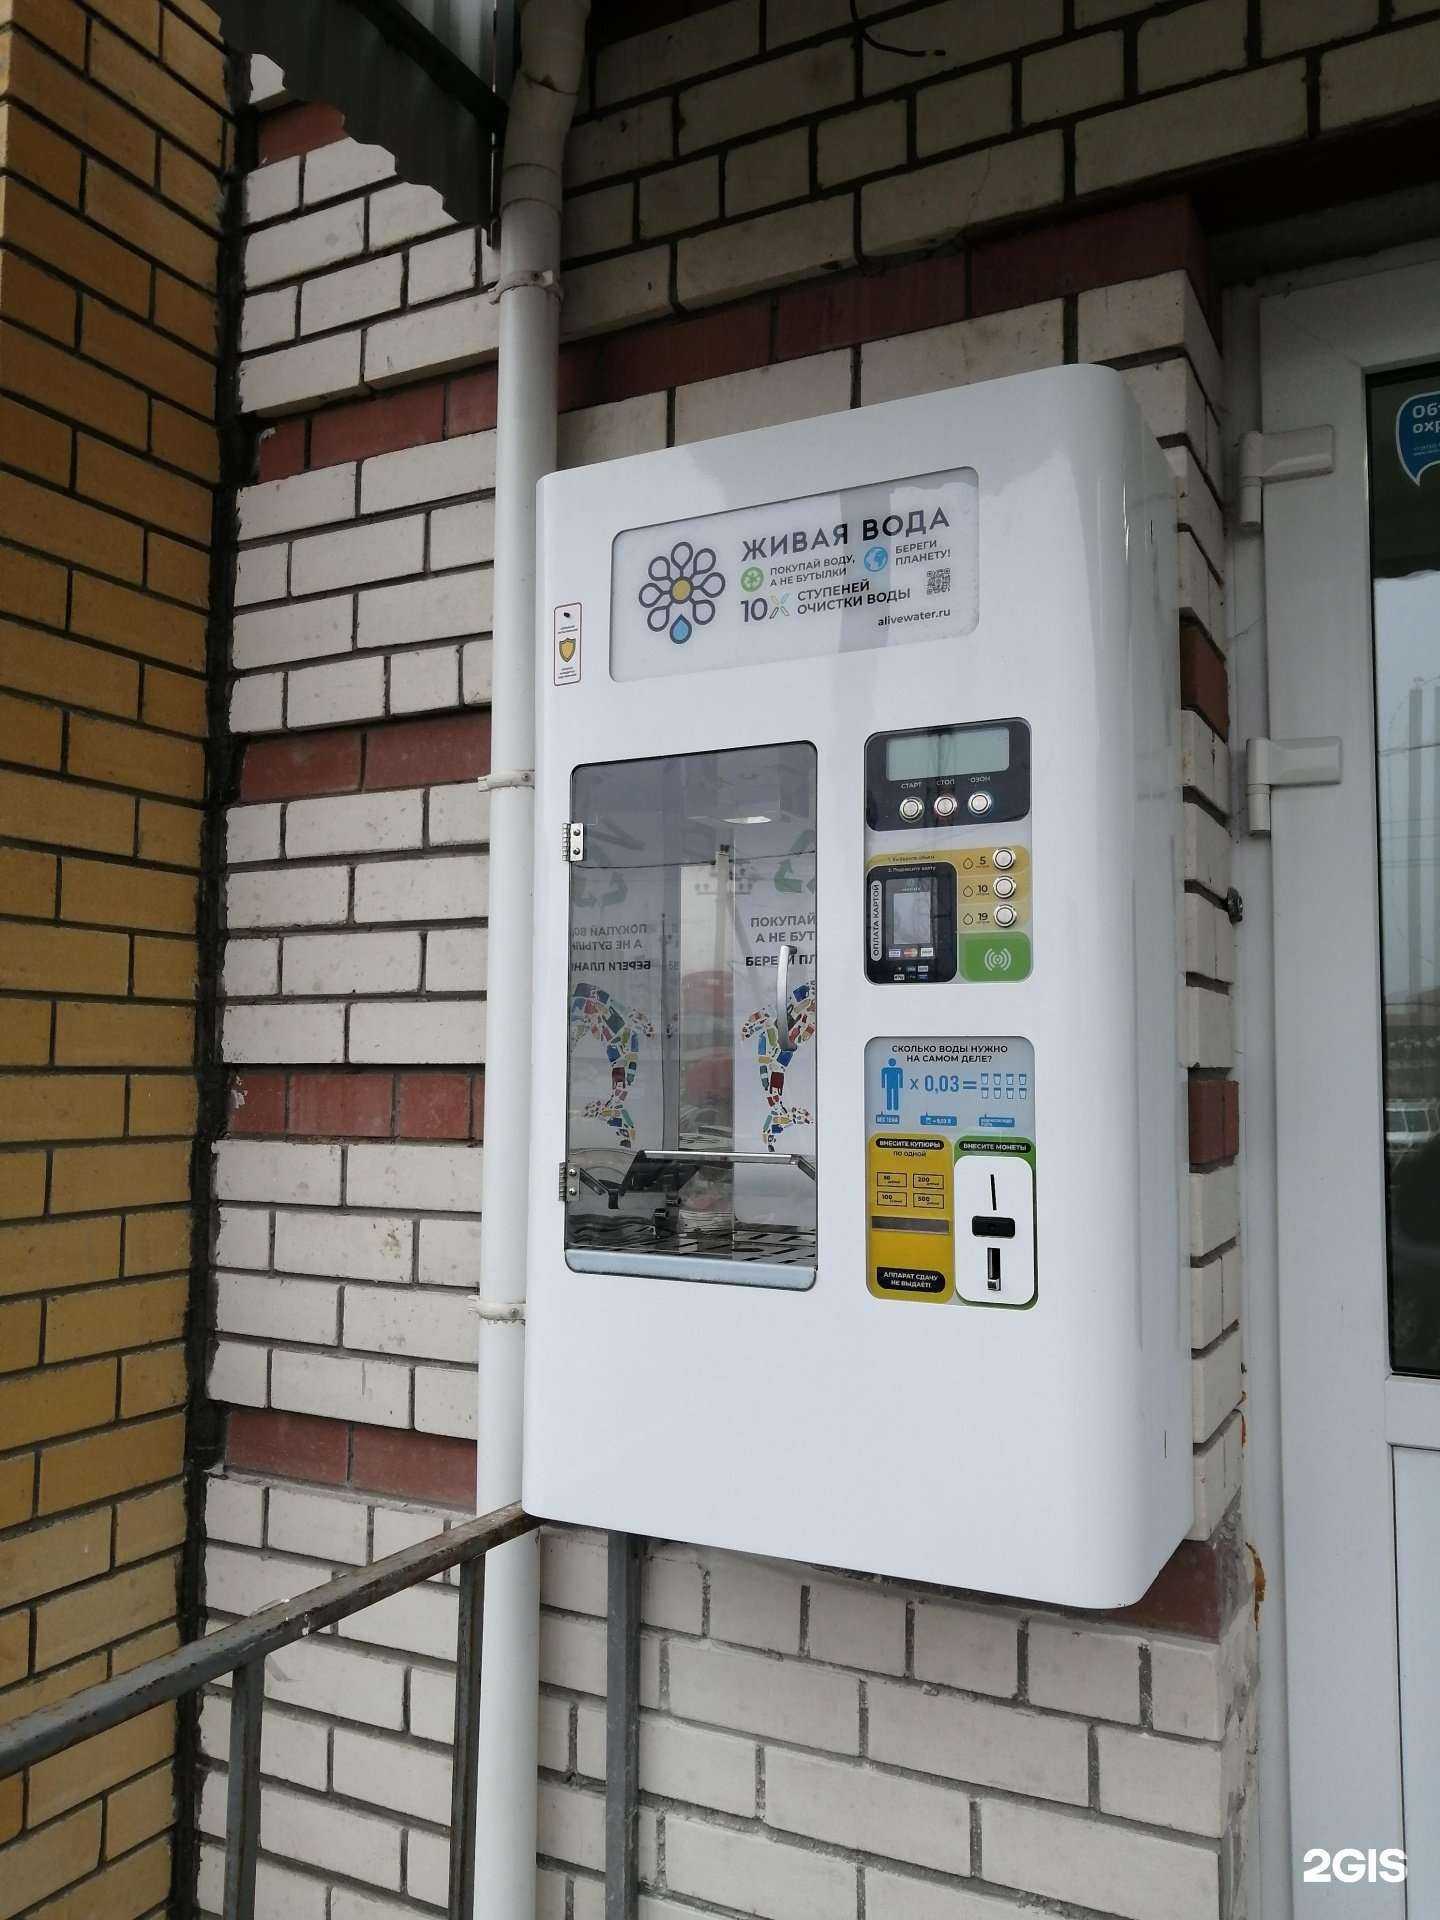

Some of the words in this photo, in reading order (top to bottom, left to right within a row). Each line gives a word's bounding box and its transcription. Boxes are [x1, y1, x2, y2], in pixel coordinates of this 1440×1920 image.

[1412, 402, 1440, 418] Об
[741, 523, 848, 561] ЖИВАЯ
[862, 506, 950, 541] ВОДА
[895, 539, 937, 555] БЕРЕГИ
[770, 558, 821, 576] ПОКУПАЙ
[824, 554, 855, 568] ВОДУ,
[895, 549, 950, 566] ПЛАНЕТУ!
[770, 579, 777, 587] А
[780, 576, 794, 586] НЕ
[796, 567, 847, 583] БУТЫЛКИ
[797, 579, 870, 601] СТУПЕНЕЙ
[797, 594, 863, 614] ОЧИСТКИ
[867, 588, 911, 606] ВОДЫ
[877, 608, 951, 626] alivewater.ru
[980, 856, 986, 865] 5
[978, 884, 988, 893] 10
[872, 884, 880, 919] КАРТОЙ
[750, 912, 816, 927] ПОКУПАЙ
[978, 912, 988, 921] 19
[755, 933, 765, 943] А
[769, 931, 786, 942] НЕ
[790, 931, 816, 942] БУТ
[745, 955, 795, 967] БЕРЕИ
[892, 1045, 937, 1053] СКОЛЬКО
[939, 1045, 968, 1054] ВОДЫ
[971, 1045, 1008, 1053] НУЖНО
[922, 1055, 959, 1063] САМОМ
[961, 1055, 993, 1063] ДЕЛЕ?
[924, 1075, 959, 1093] 0,03
[879, 1140, 910, 1148] ВНЕСИТЕ
[883, 1271, 915, 1280] АППАРАТ
[916, 1273, 938, 1281] СДАЧУ
